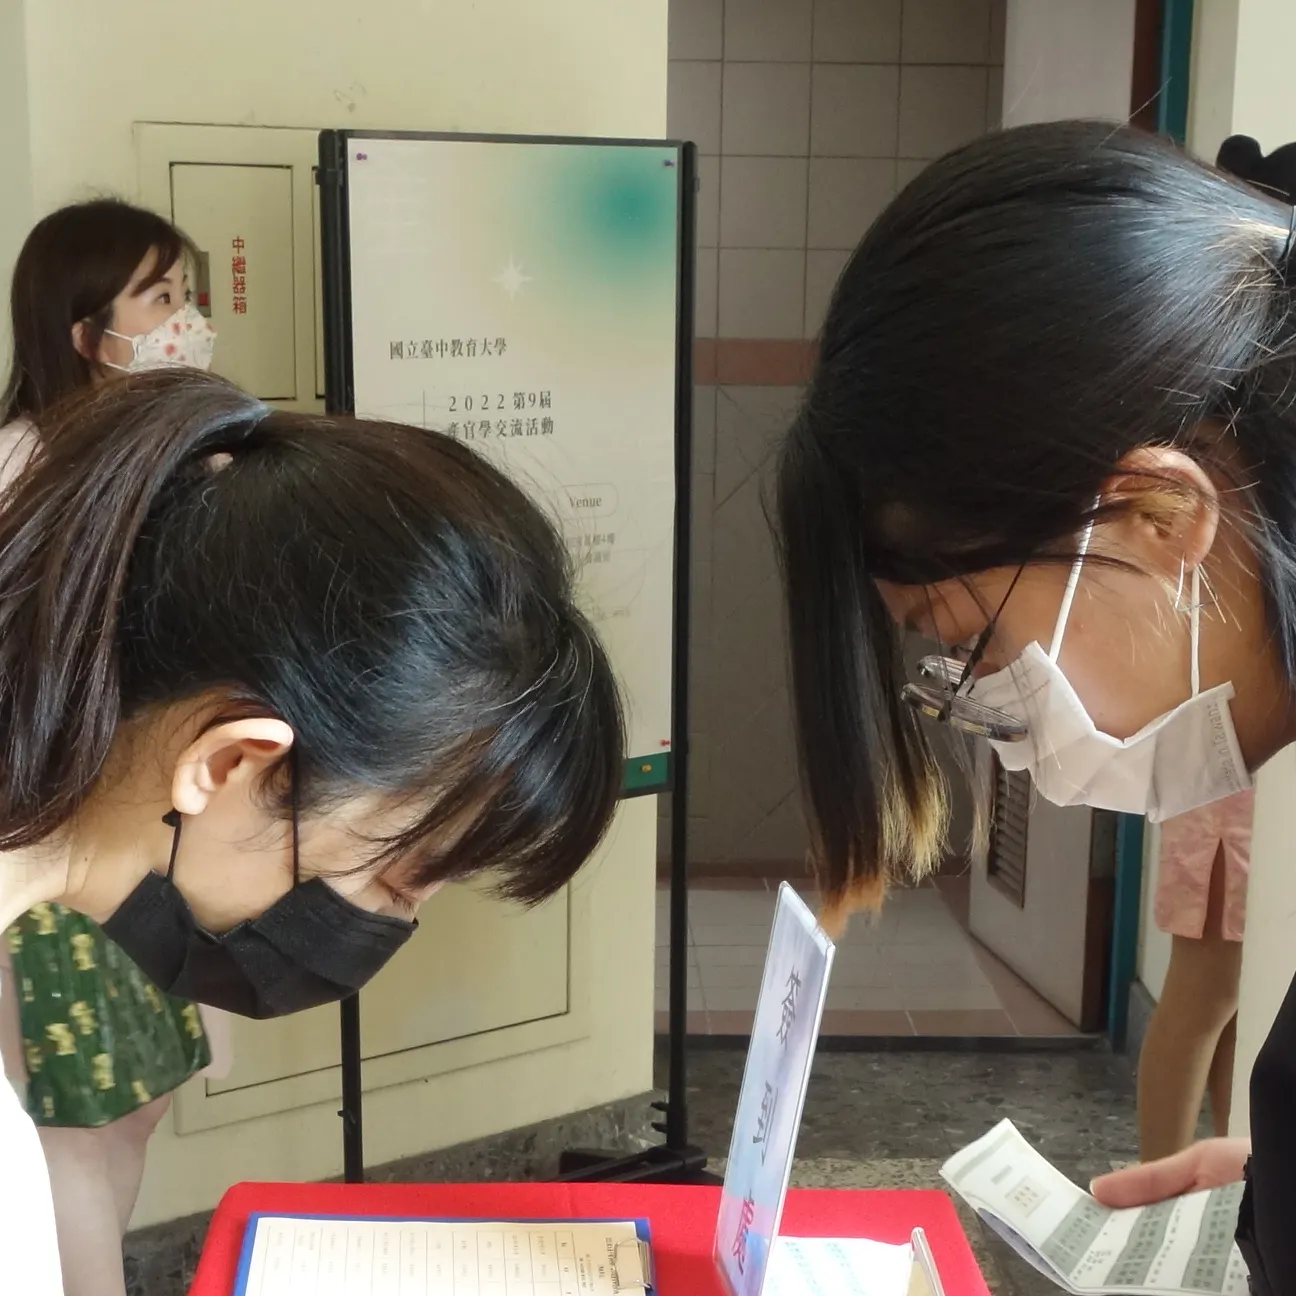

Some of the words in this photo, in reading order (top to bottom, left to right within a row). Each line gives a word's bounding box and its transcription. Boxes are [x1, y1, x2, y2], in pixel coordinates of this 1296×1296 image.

[390, 338, 507, 360] 國立臺中教育大學
[449, 394, 505, 412] 2022
[513, 391, 552, 411] 第9屆
[449, 417, 554, 440] 產官學交流活動
[569, 496, 602, 508] Venue
